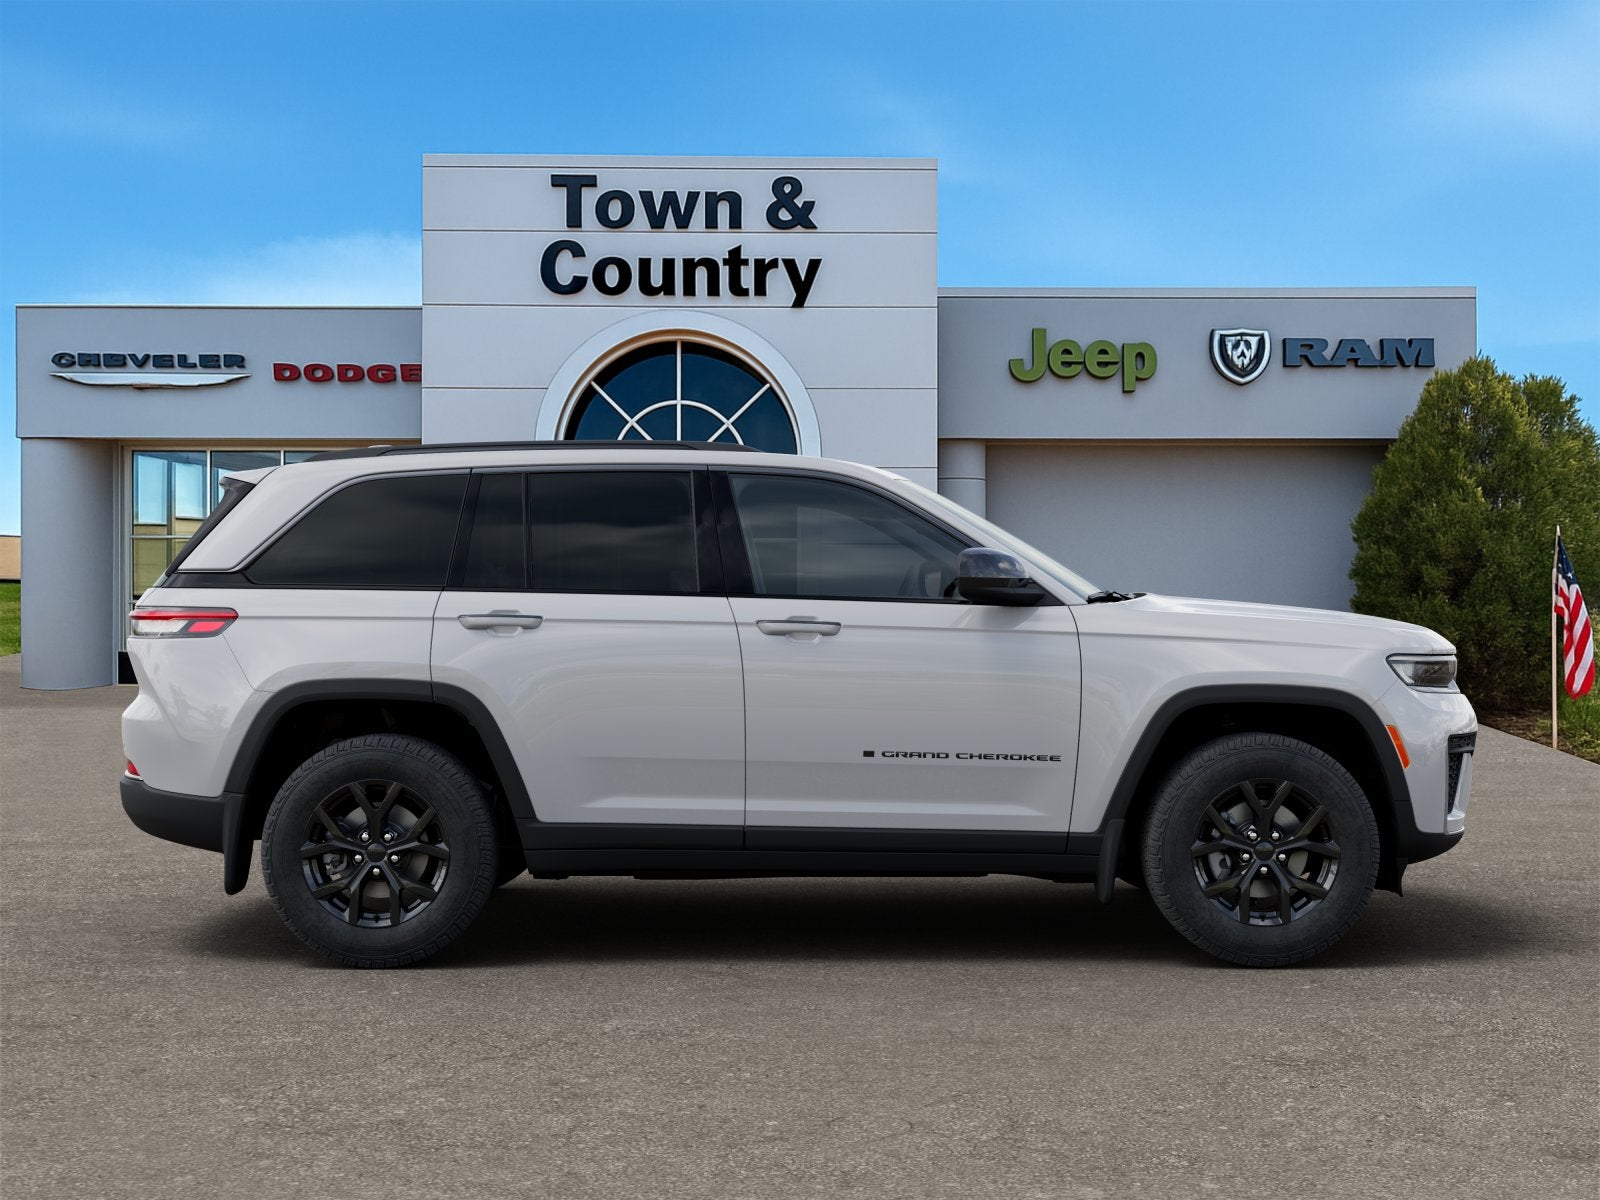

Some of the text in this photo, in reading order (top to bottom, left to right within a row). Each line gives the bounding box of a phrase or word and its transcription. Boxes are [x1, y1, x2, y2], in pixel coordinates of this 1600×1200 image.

[551, 174, 818, 230] Town &
[540, 239, 822, 308] Country
[273, 363, 422, 383] DODGE
[1008, 327, 1158, 393] Jeep
[1282, 337, 1436, 368] RAM
[881, 750, 1062, 762] GRAND CHEROKEE
